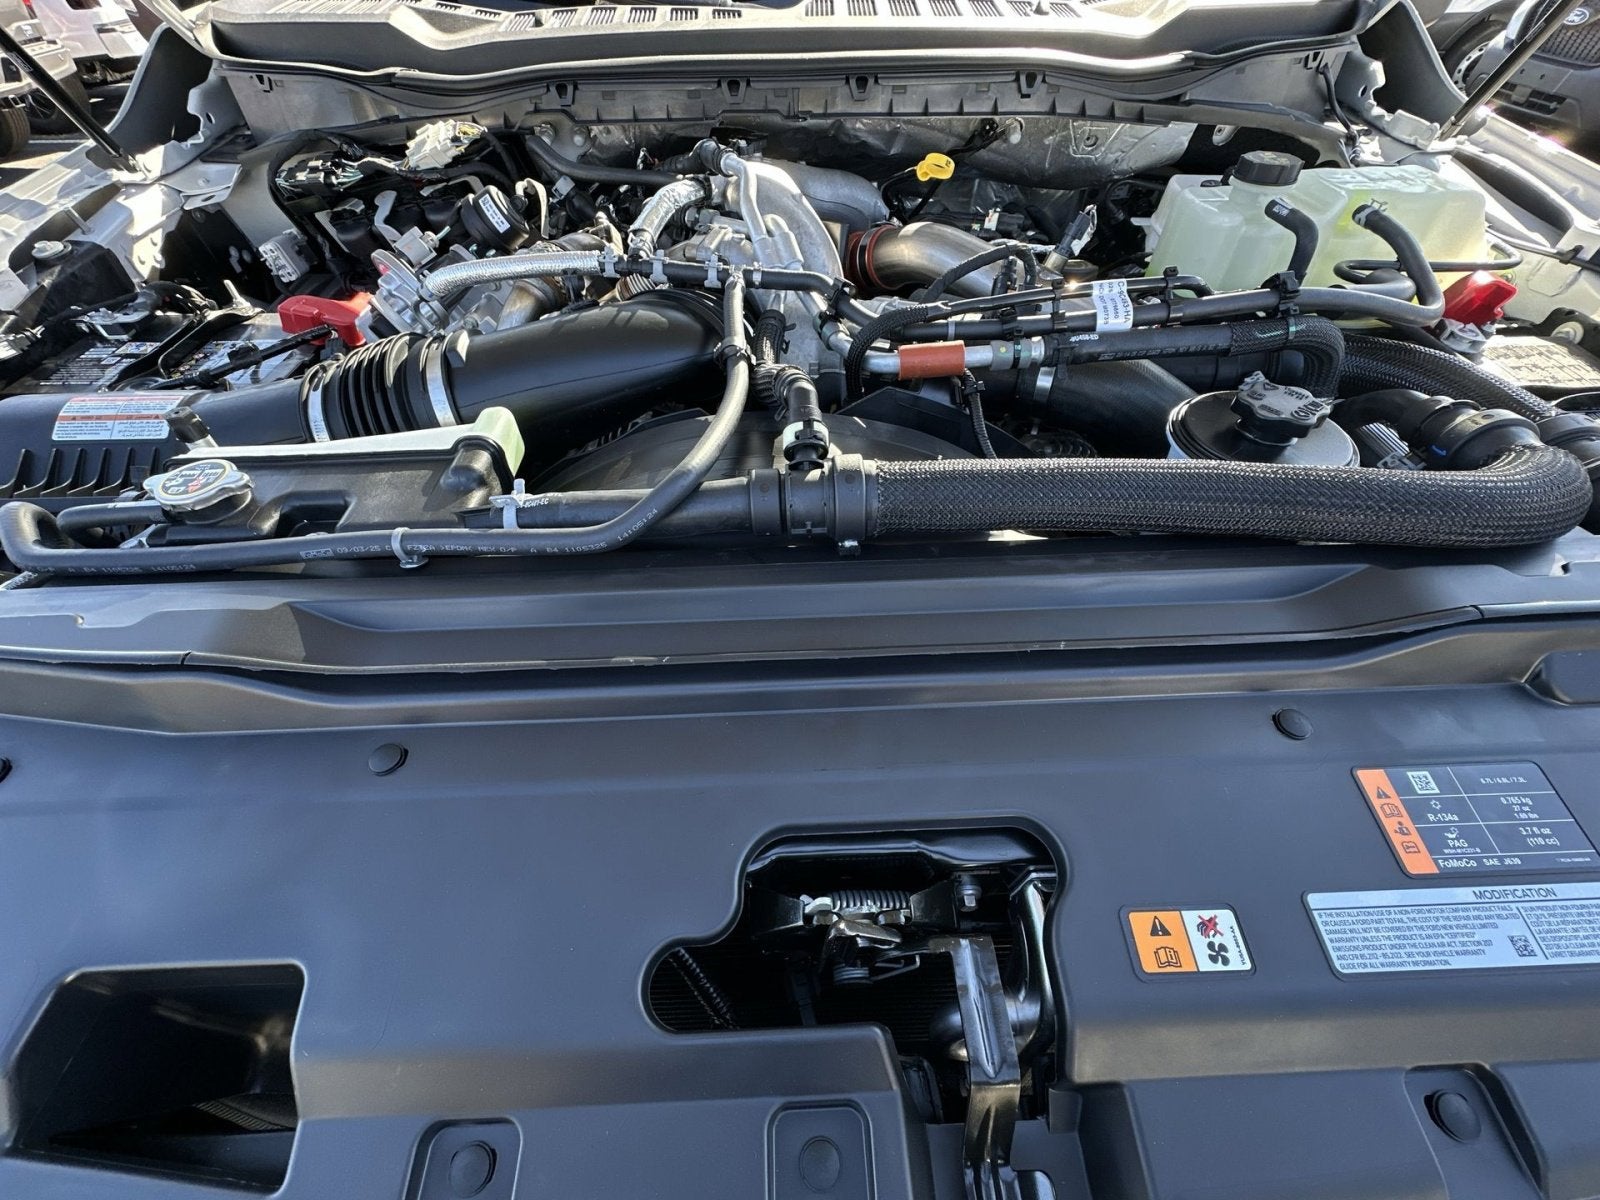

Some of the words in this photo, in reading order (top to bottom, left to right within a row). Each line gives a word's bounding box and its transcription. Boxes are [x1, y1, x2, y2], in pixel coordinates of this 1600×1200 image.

[1521, 796, 1533, 805] kg
[1427, 813, 1459, 822] R-134a
[1519, 827, 1532, 835] 3.7
[1447, 839, 1468, 848] PAG
[1526, 838, 1545, 847] (110
[1545, 837, 1560, 846] cc)
[1438, 858, 1477, 868] FoMoCo
[1483, 858, 1501, 866] SAE
[1472, 888, 1558, 901] MODIFICATION
[1475, 921, 1499, 929] LIMITED
